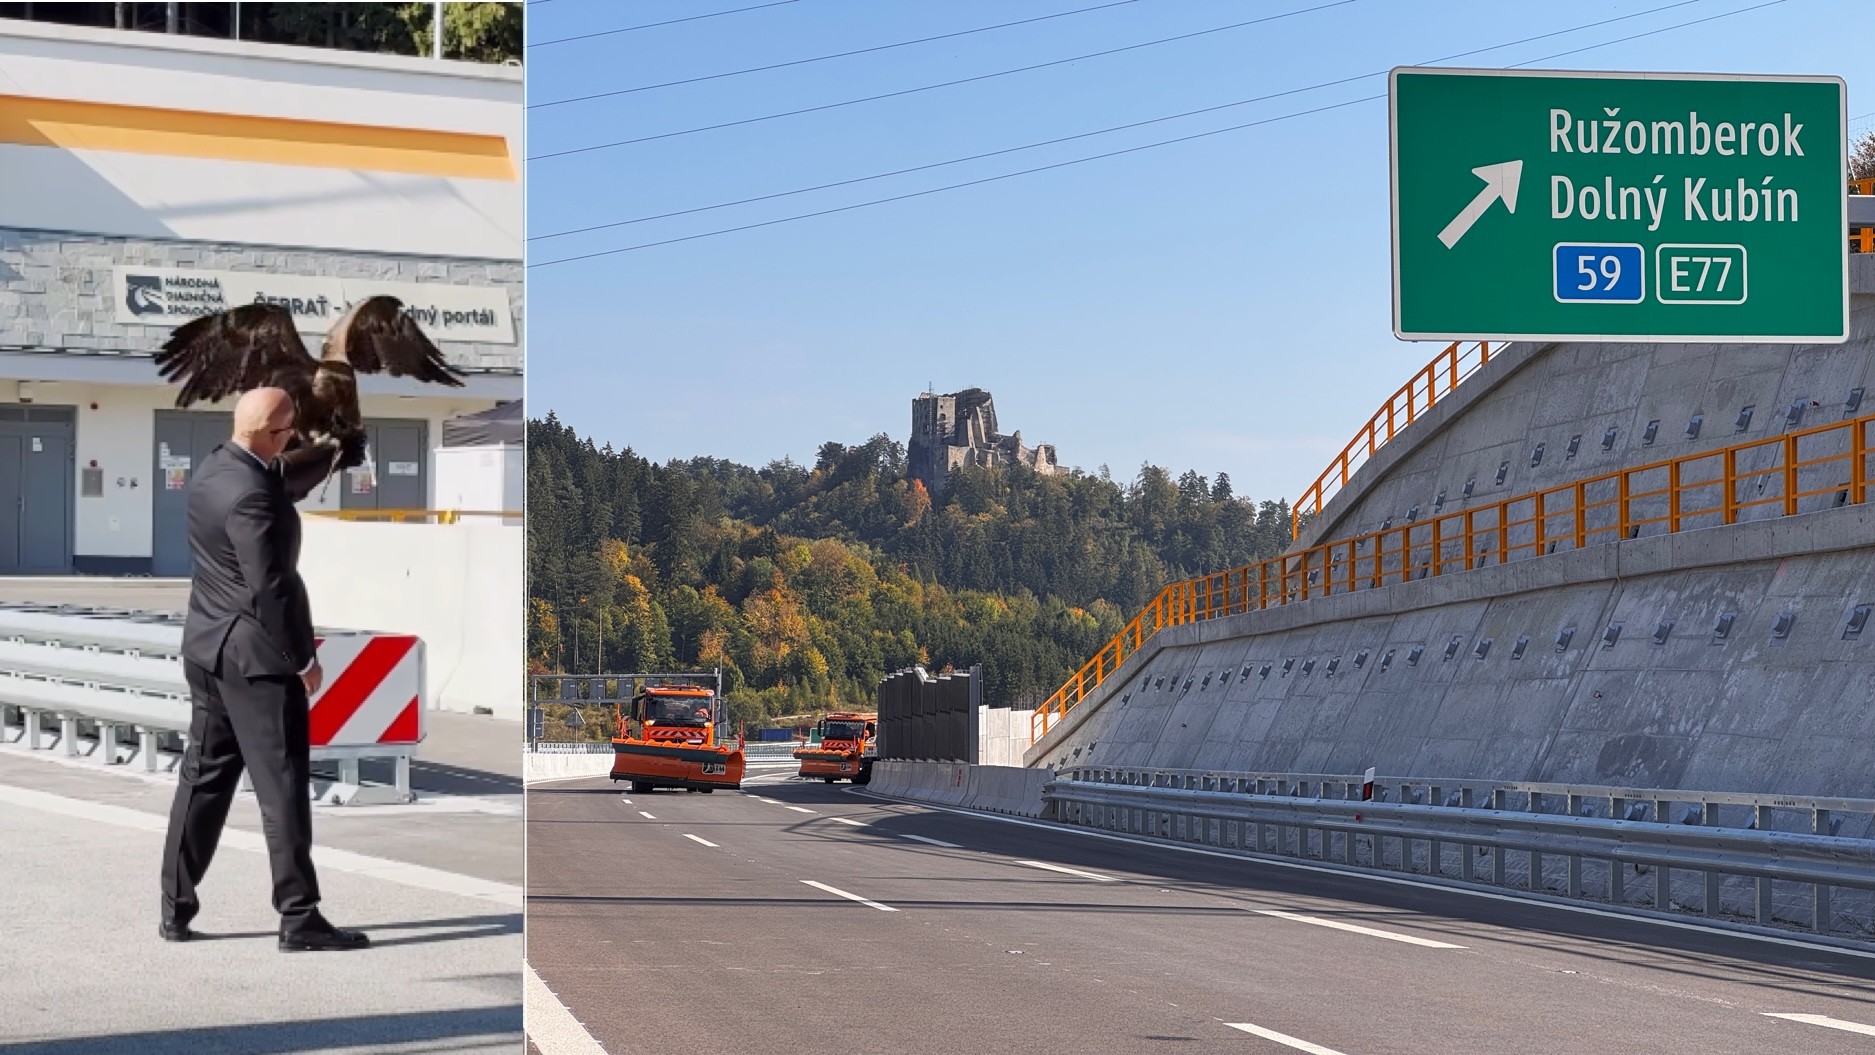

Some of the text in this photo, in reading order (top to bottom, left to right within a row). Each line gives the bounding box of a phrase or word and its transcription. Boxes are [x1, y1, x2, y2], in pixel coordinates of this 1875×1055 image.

[1550, 107, 1805, 157] Ružomberok
[1551, 174, 1799, 231] Dolný Kubín
[1577, 255, 1622, 291] 59
[1671, 256, 1732, 292] E77
[442, 308, 495, 327] portál
